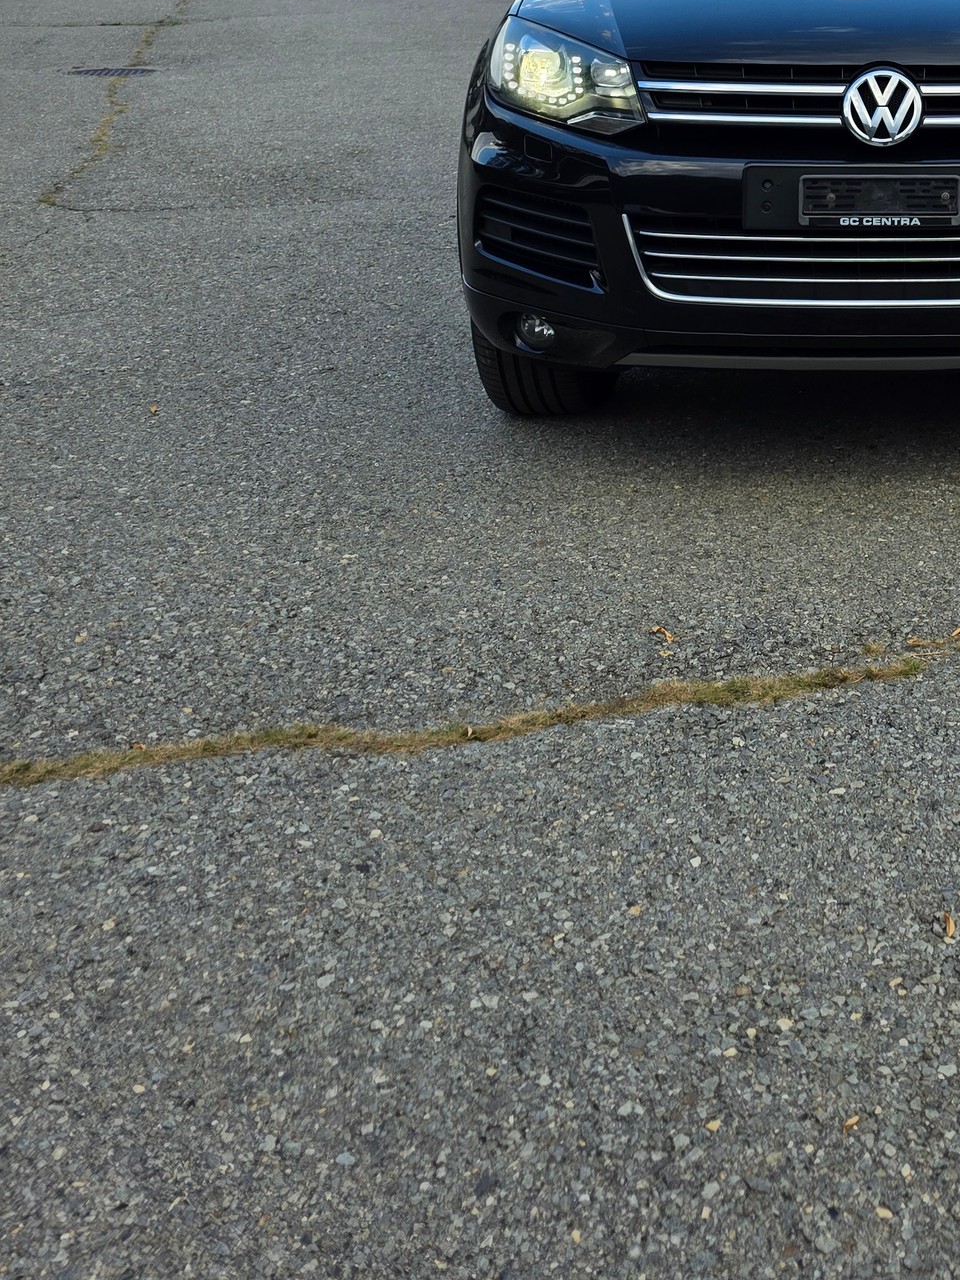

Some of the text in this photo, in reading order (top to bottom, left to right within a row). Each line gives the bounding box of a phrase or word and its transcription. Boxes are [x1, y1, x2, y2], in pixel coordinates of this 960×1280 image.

[844, 70, 921, 146] VW
[839, 217, 921, 226] GC CENTRA
